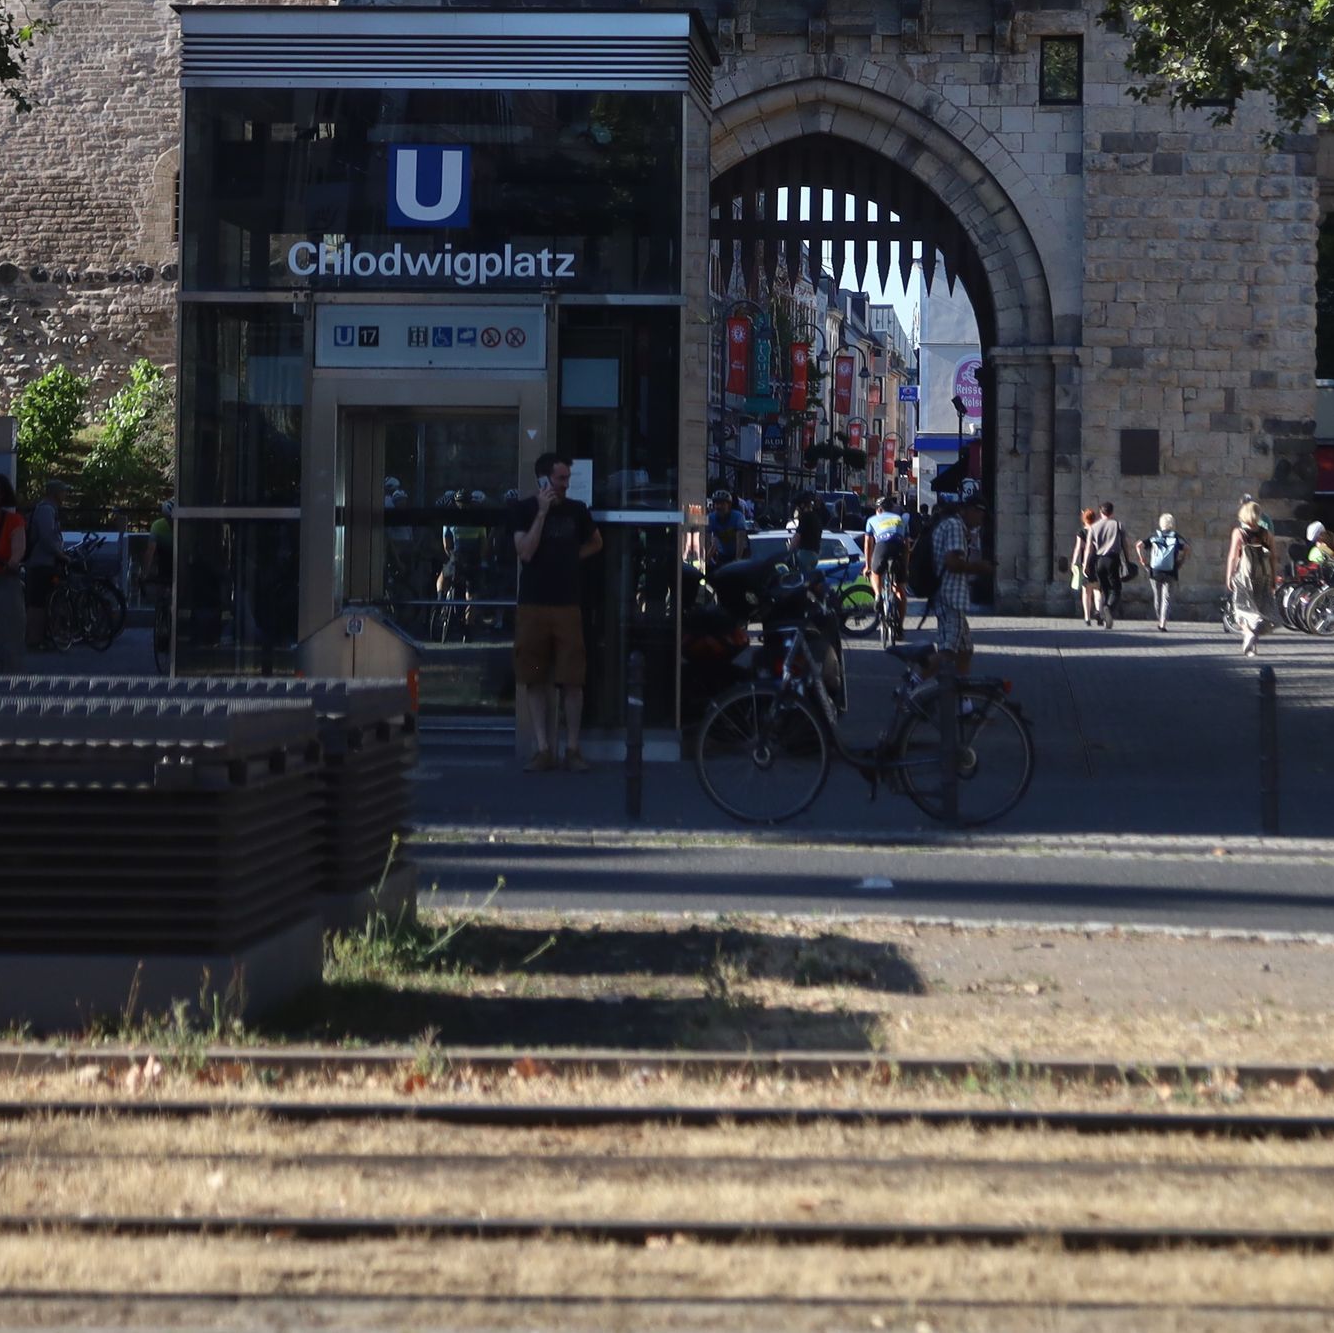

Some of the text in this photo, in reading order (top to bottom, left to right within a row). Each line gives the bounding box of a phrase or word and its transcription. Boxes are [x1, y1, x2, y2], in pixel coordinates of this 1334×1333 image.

[395, 148, 463, 222] U
[287, 242, 576, 286] Chlodwigplatz
[336, 327, 378, 345] U 17
[764, 438, 784, 446] ALDI
